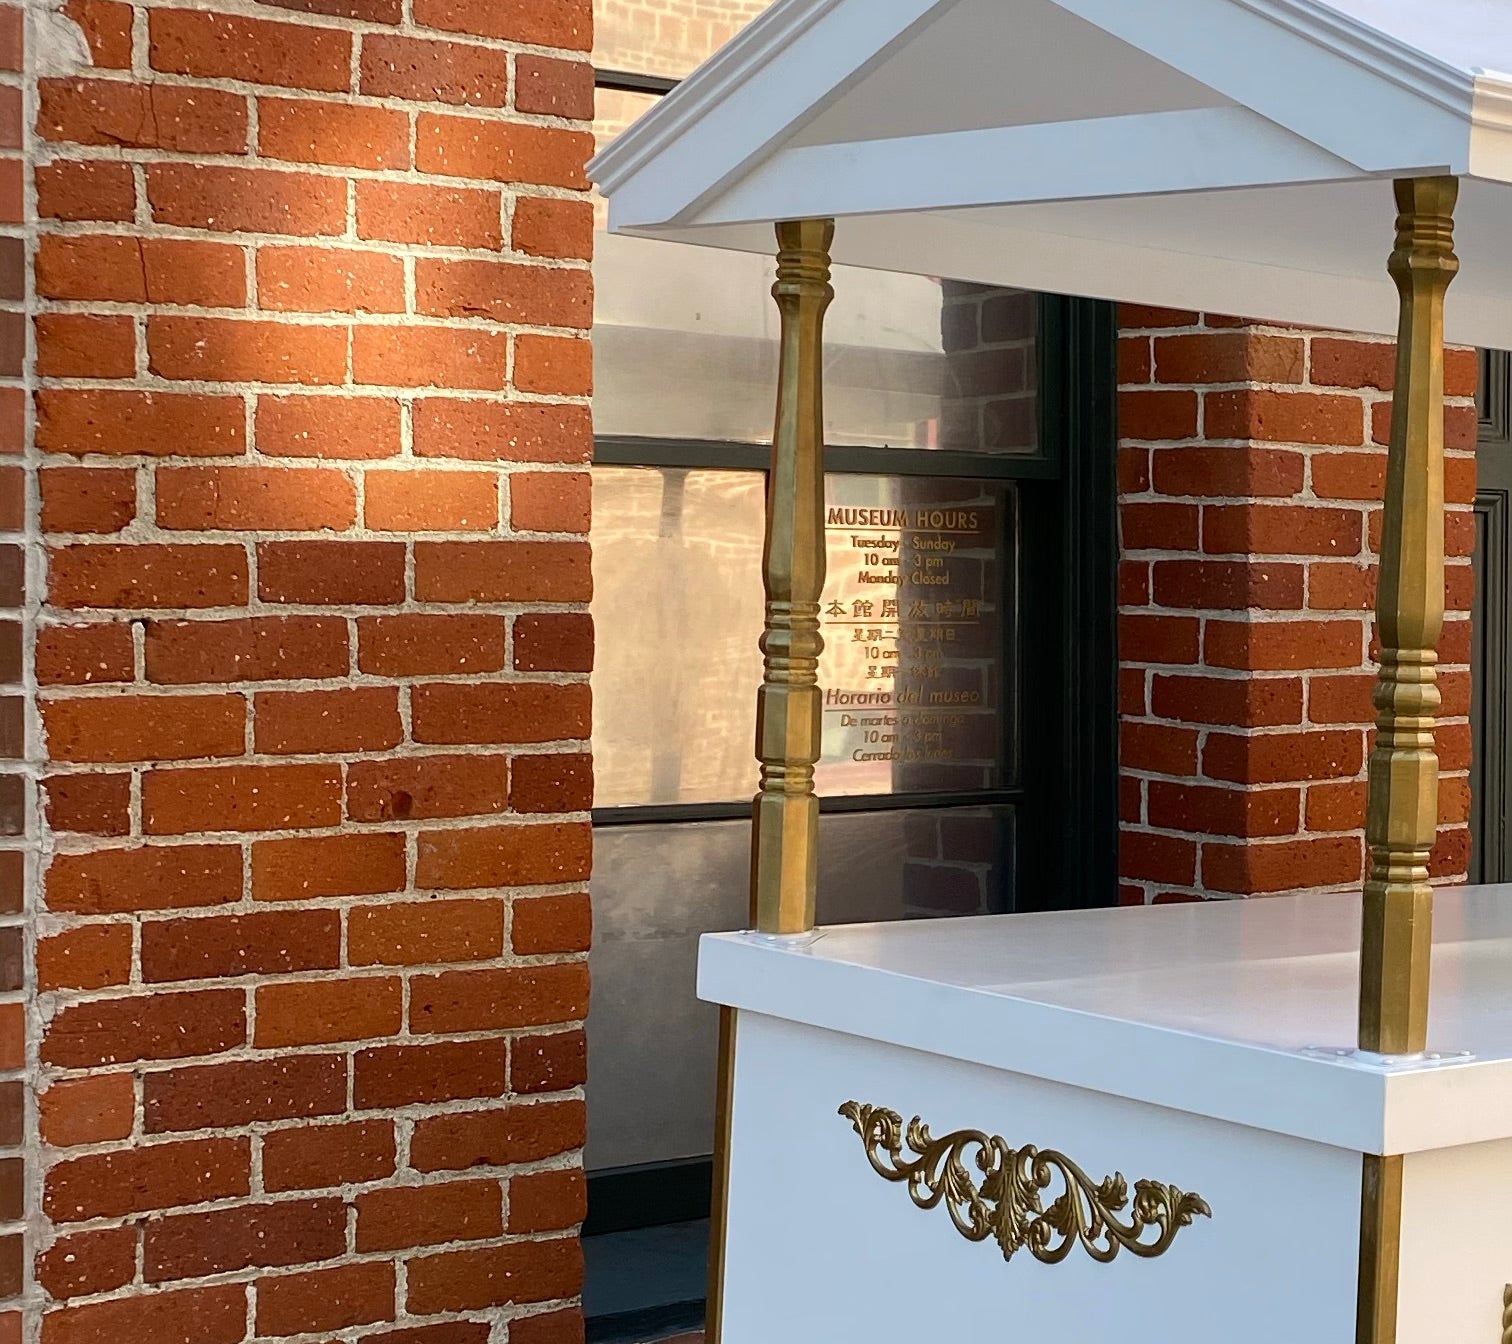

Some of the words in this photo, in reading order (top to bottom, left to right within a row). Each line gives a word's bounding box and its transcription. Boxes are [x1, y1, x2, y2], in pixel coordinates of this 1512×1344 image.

[828, 507, 909, 527] MUSEUM
[916, 510, 978, 529] HOURS
[850, 535, 900, 552] Tuesday
[912, 536, 956, 553] Sunday
[864, 553, 879, 566] 10
[913, 554, 921, 567] 3
[925, 557, 944, 570] pm
[858, 571, 908, 588] Monday
[911, 571, 950, 585] Closed
[864, 646, 880, 659] 10
[826, 688, 892, 705] Horario
[929, 688, 980, 702] museo
[840, 714, 858, 727] De
[860, 714, 898, 727] martes
[863, 730, 879, 743] 10
[881, 734, 898, 743] am
[852, 746, 900, 762] Cerrado
